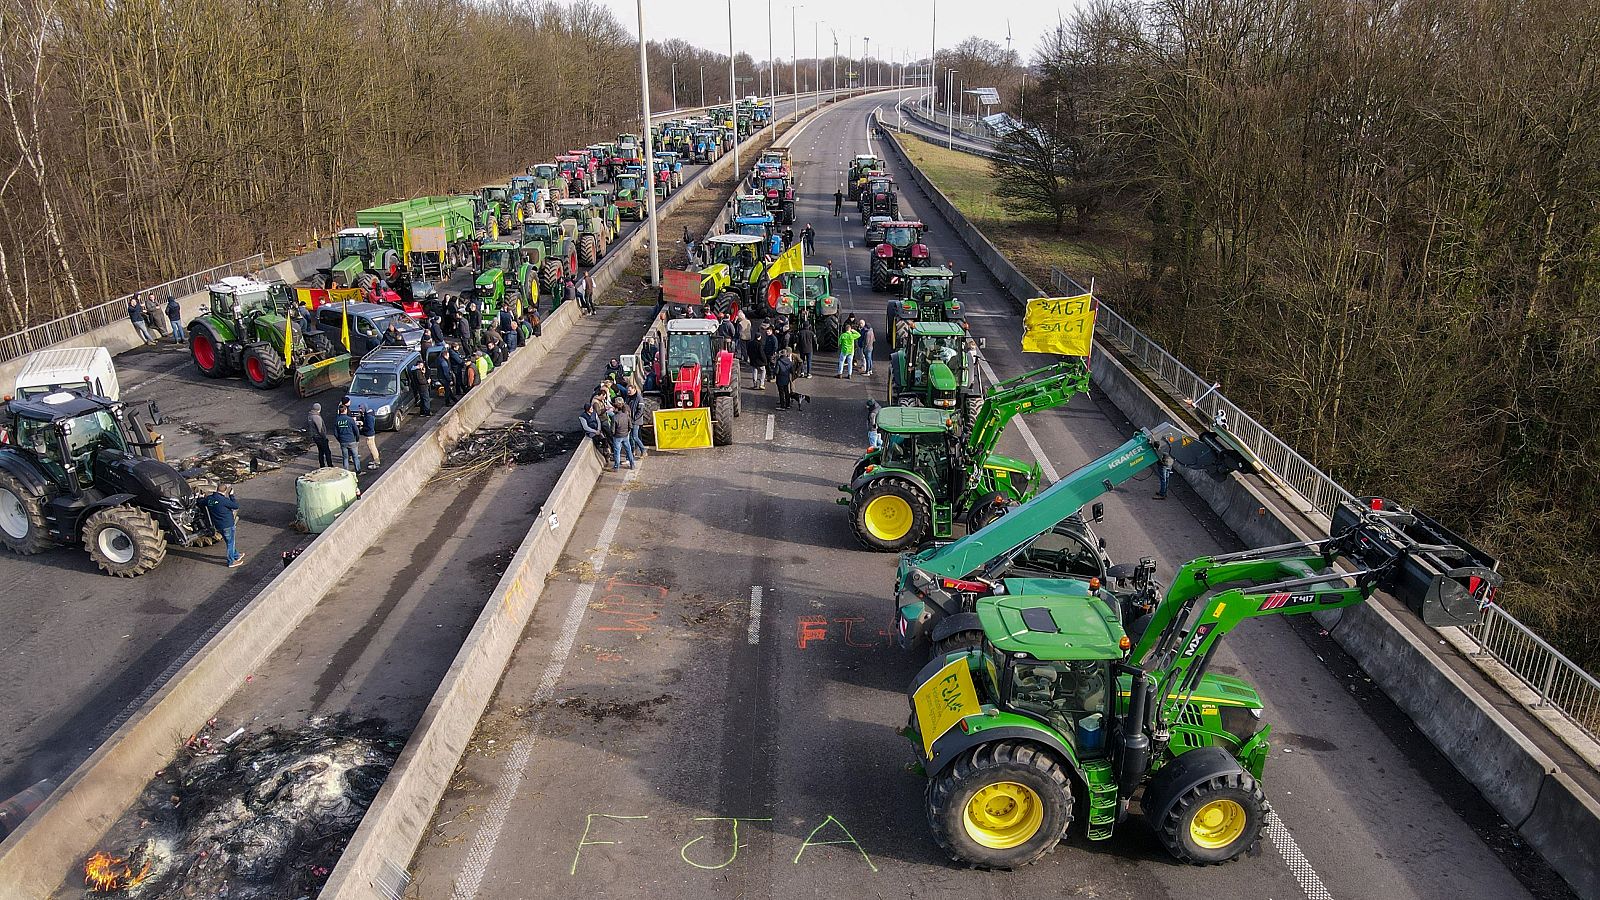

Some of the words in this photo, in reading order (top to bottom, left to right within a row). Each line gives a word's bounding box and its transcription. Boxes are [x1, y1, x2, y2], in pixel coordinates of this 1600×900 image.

[663, 417, 691, 432] FJA
[1108, 445, 1145, 470] KRAMER
[1184, 633, 1204, 657] MX
[939, 673, 963, 705] FJA
[570, 803, 878, 875] FJA
